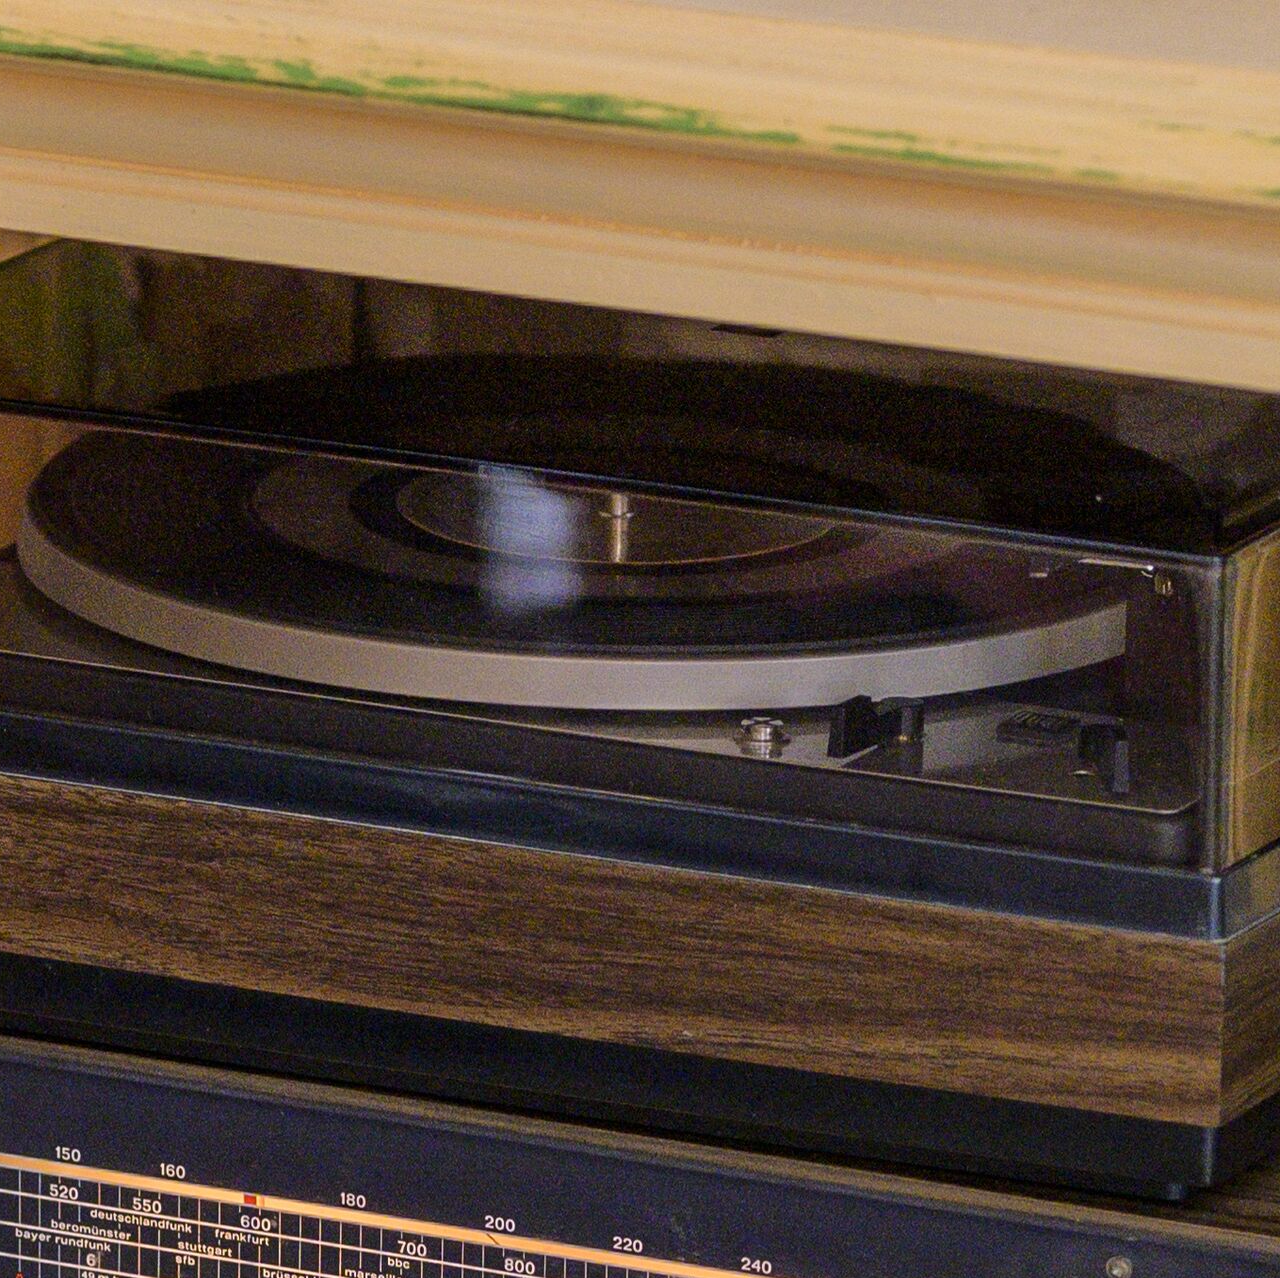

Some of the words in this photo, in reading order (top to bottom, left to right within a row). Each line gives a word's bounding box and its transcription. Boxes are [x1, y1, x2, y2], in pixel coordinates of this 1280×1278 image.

[56, 1146, 81, 1162] 150
[160, 1163, 186, 1179] 160
[340, 1192, 366, 1208] 180
[484, 1215, 515, 1232] 200
[613, 1236, 643, 1253] 220
[741, 1257, 772, 1274] 240
[49, 1184, 79, 1200] 520
[132, 1198, 162, 1214] 550
[240, 1215, 271, 1231] 600
[397, 1240, 427, 1257] 700
[504, 1258, 535, 1275] 800
[51, 1219, 131, 1241] beromünster
[90, 1209, 192, 1234] deutschlandfunk
[15, 1228, 51, 1245] bayer
[54, 1233, 111, 1252] rundfunk
[215, 1229, 269, 1247] frankfurt
[177, 1240, 232, 1258] stuttgart
[86, 1254, 95, 1266] 6
[175, 1255, 195, 1266] sfb
[387, 1257, 410, 1270] bbc
